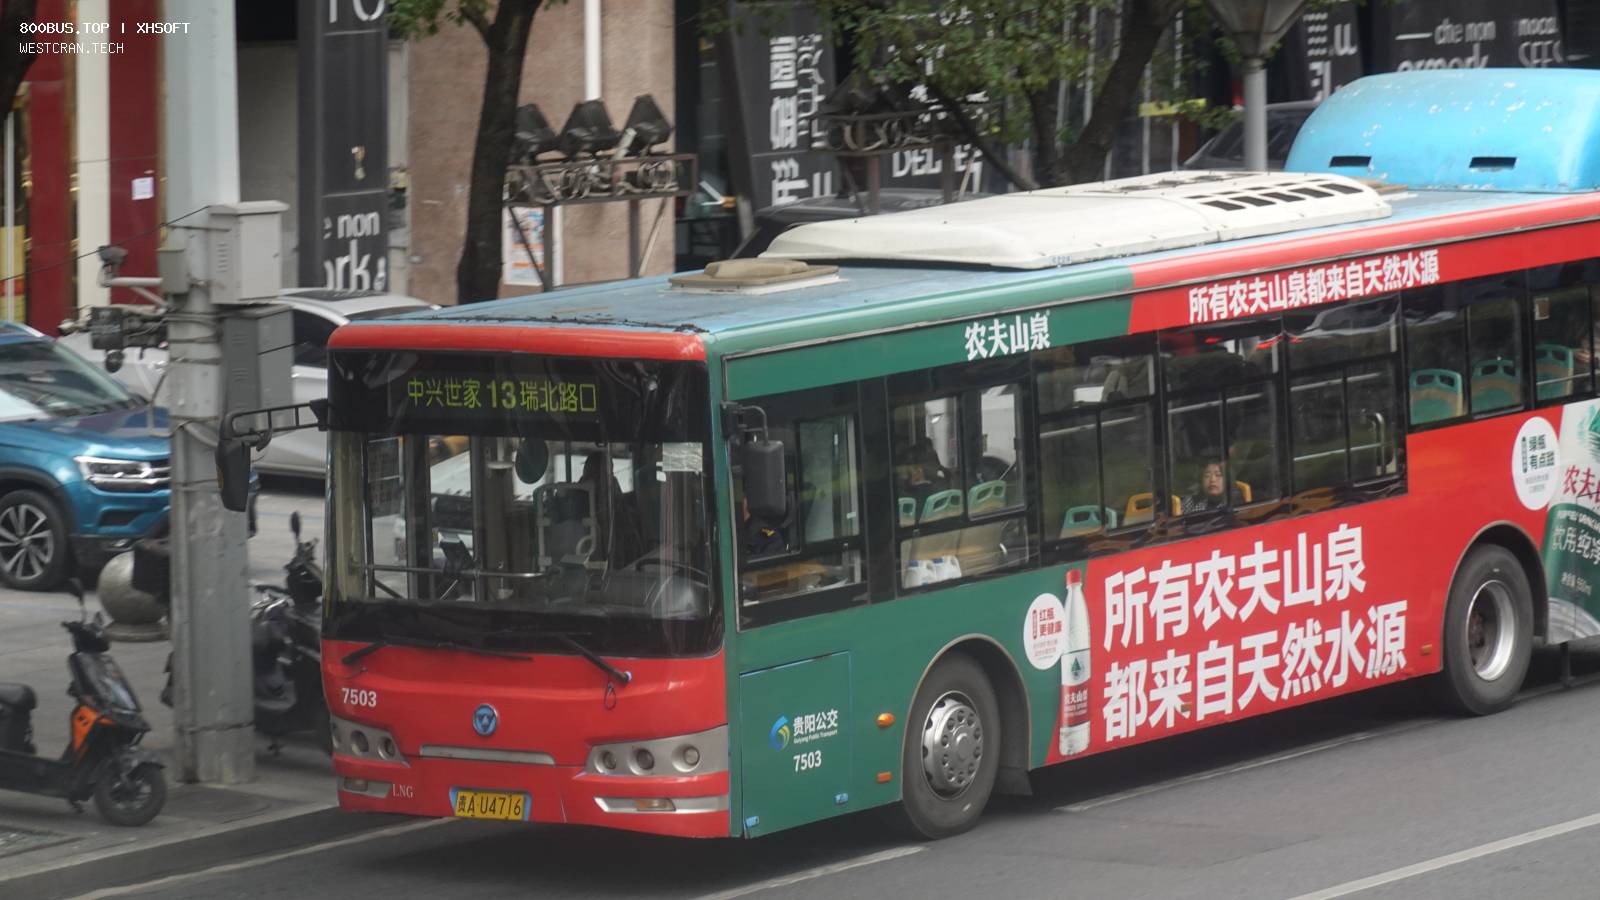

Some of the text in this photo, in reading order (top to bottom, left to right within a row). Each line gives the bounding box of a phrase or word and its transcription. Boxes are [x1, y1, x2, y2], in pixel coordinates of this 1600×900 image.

[337, 211, 380, 239] non
[1188, 249, 1440, 324] 所有农夫山泉都来自天然水源
[964, 313, 1051, 361] 农夫山泉
[407, 377, 597, 412] 中兴世家 13 瑞北路口
[1103, 523, 1367, 652] 所有农夫山泉
[1102, 599, 1409, 743] 都来自天然水源
[341, 687, 378, 708] 7503
[793, 708, 839, 737] 贵阳公交
[793, 750, 822, 772] 7503
[392, 783, 414, 798] LNG
